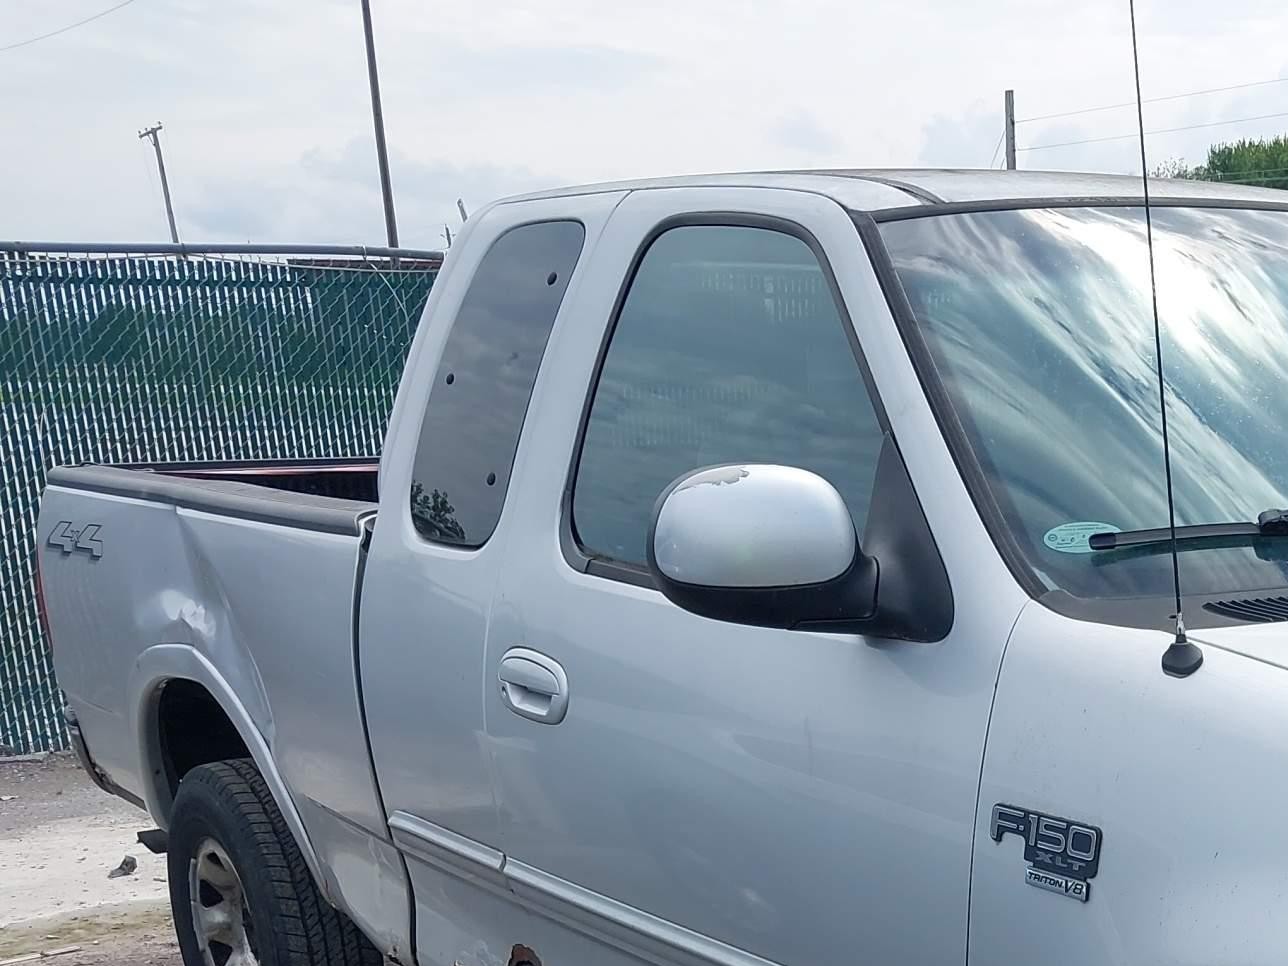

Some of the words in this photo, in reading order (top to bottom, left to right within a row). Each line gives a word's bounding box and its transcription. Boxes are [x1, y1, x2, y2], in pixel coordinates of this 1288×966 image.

[1035, 850, 1086, 871] XLT
[1027, 871, 1063, 889] TRITON
[1063, 879, 1085, 896] V8
